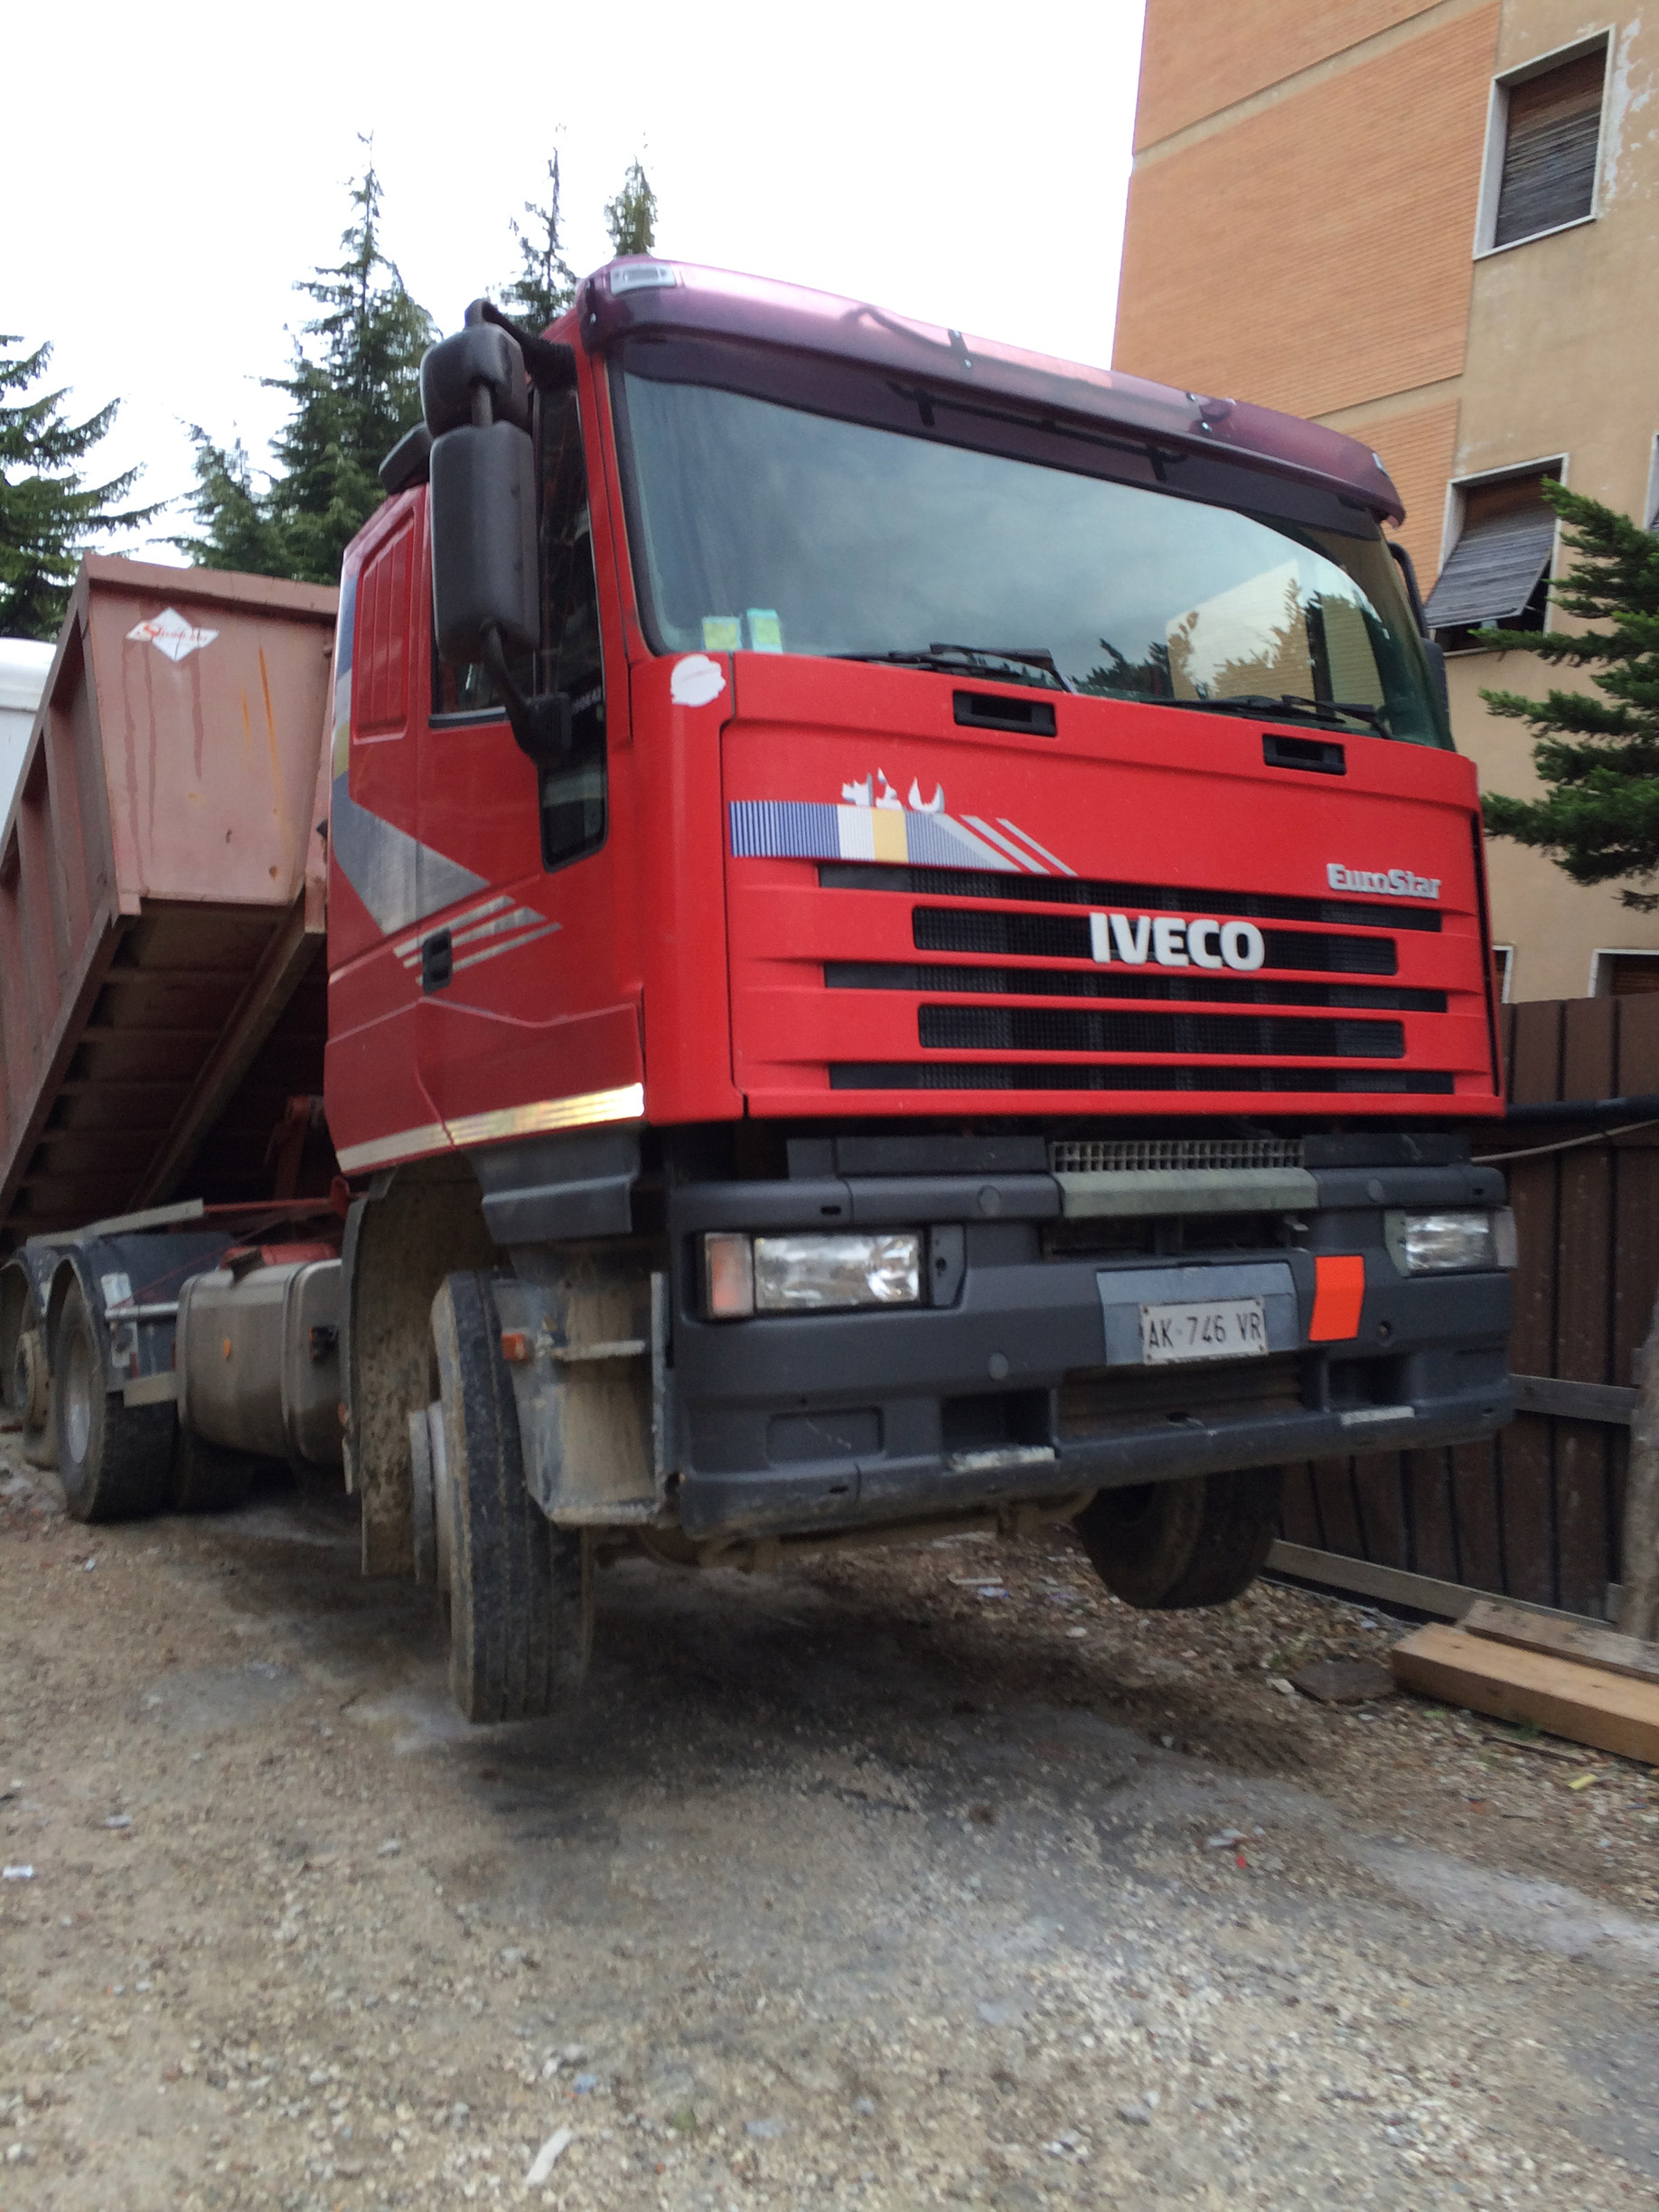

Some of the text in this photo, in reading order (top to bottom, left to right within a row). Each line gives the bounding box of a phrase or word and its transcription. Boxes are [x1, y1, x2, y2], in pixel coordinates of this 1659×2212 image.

[1326, 863, 1442, 899] EuroStar
[1090, 912, 1265, 971] IVECO
[1148, 1312, 1262, 1349] AK 746 VR
